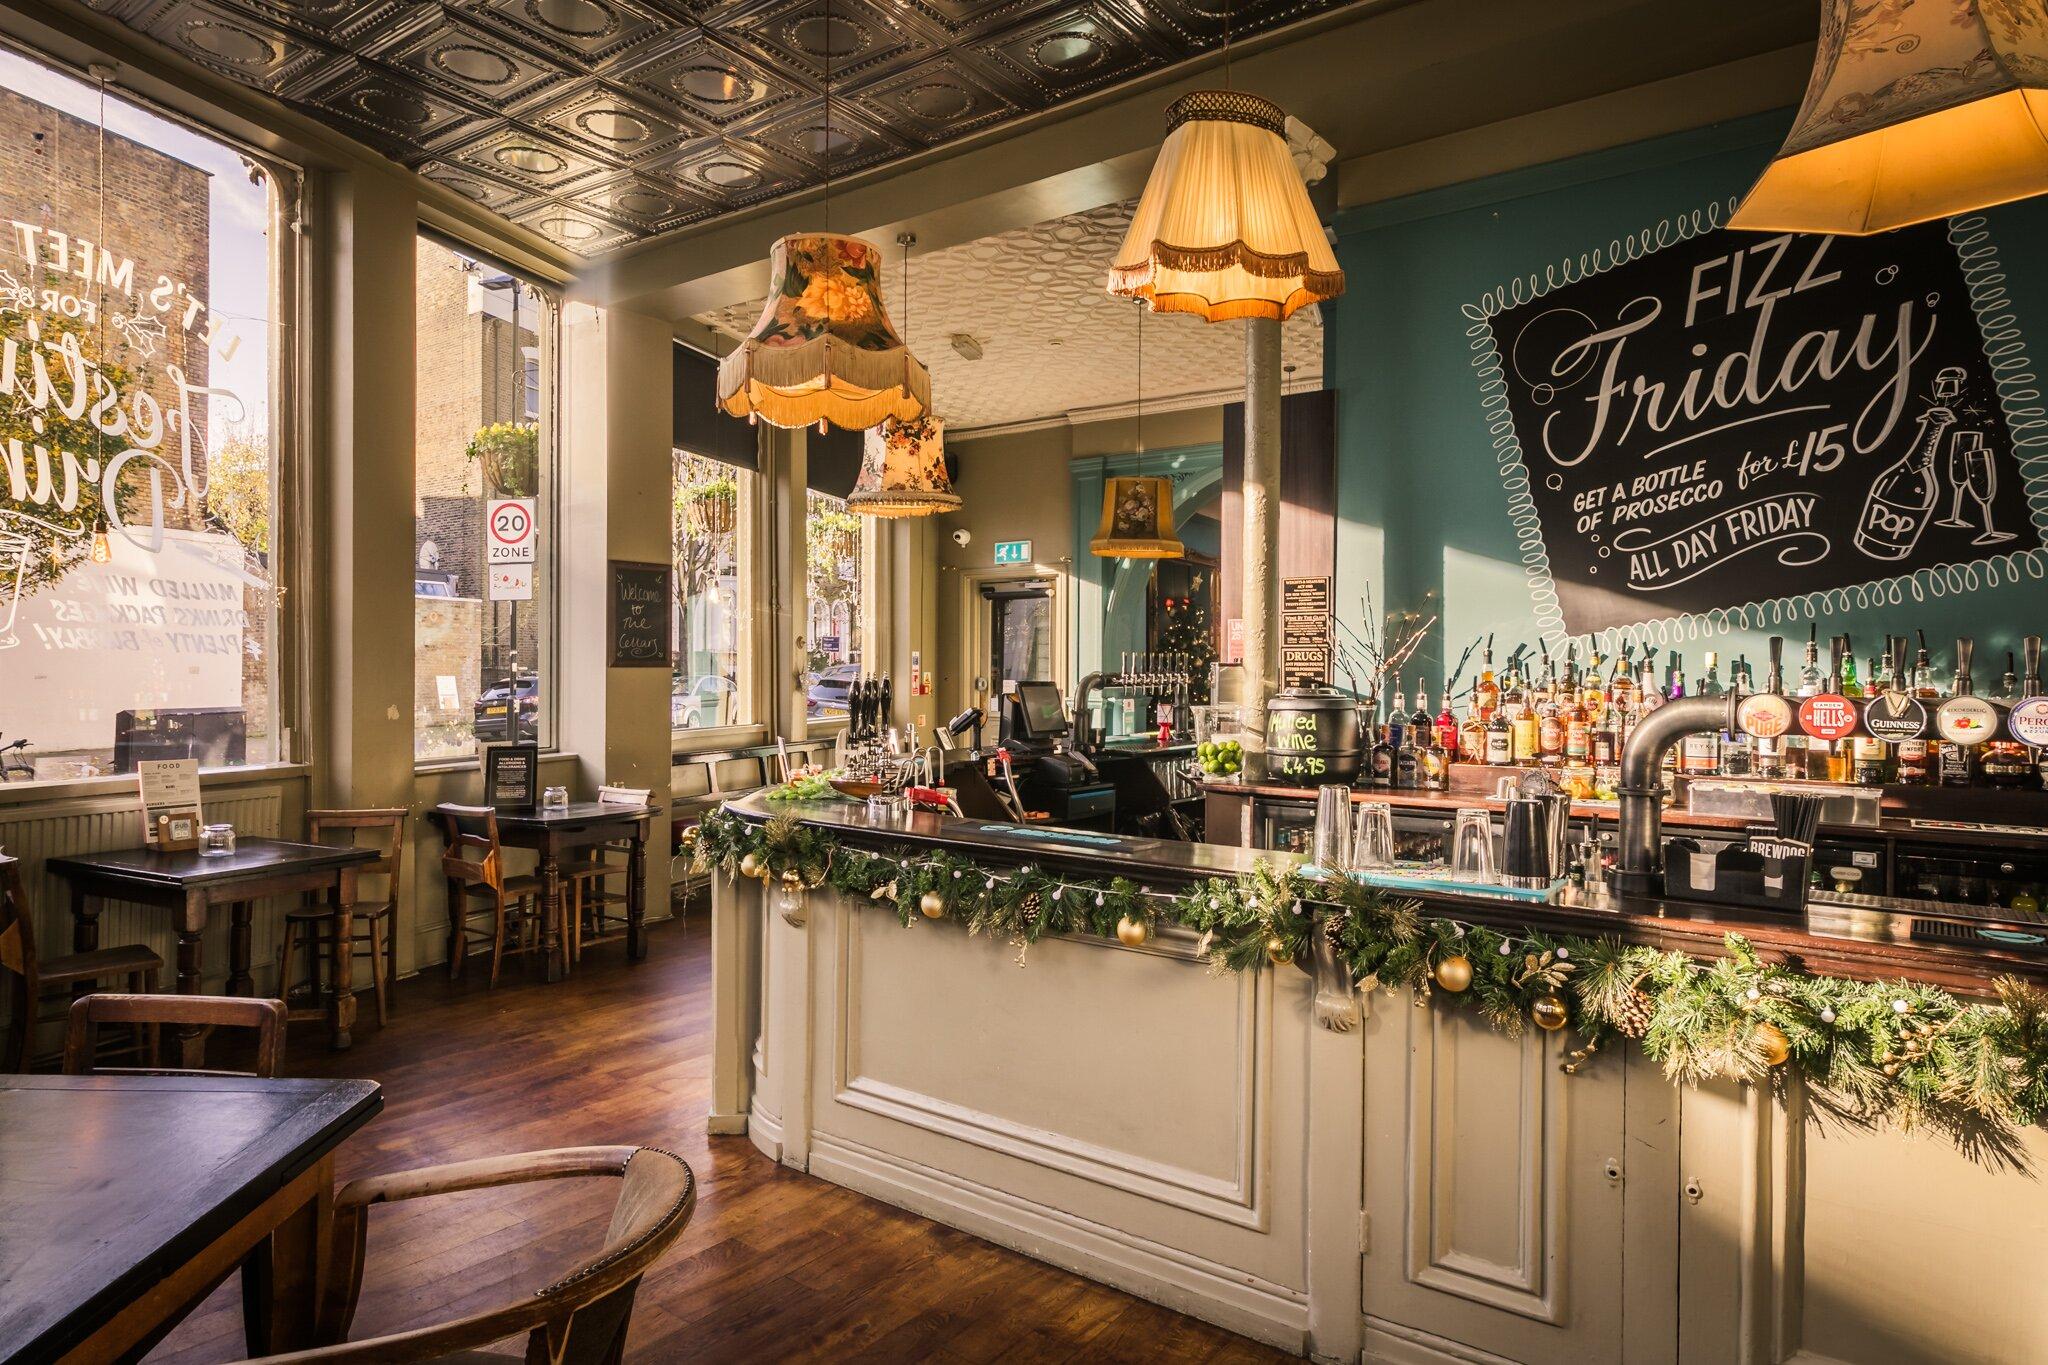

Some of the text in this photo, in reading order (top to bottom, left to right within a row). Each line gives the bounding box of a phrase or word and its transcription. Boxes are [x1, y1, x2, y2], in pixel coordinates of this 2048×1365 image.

[1685, 233, 1842, 327] FIZZ
[1543, 294, 1937, 467] Friday
[1738, 451, 1778, 490] for
[1573, 459, 1707, 513] GET A BOTTLE
[1576, 479, 1723, 533] OF PROSECCO
[497, 515, 525, 532] 20
[1868, 504, 1914, 541] POP
[1629, 497, 1816, 582] ALL DAY FRIDAY
[492, 547, 530, 558] ZONE
[620, 582, 662, 602] Welcome
[631, 604, 645, 616] to
[618, 633, 659, 650] Cellars
[1286, 651, 1323, 661] DRUGS
[1270, 713, 1317, 732] Mulled
[1745, 714, 1782, 735] PURE
[1813, 709, 1844, 727] HELLS
[1871, 719, 1920, 729] GUINNESS
[1282, 757, 1326, 775] £4.95
